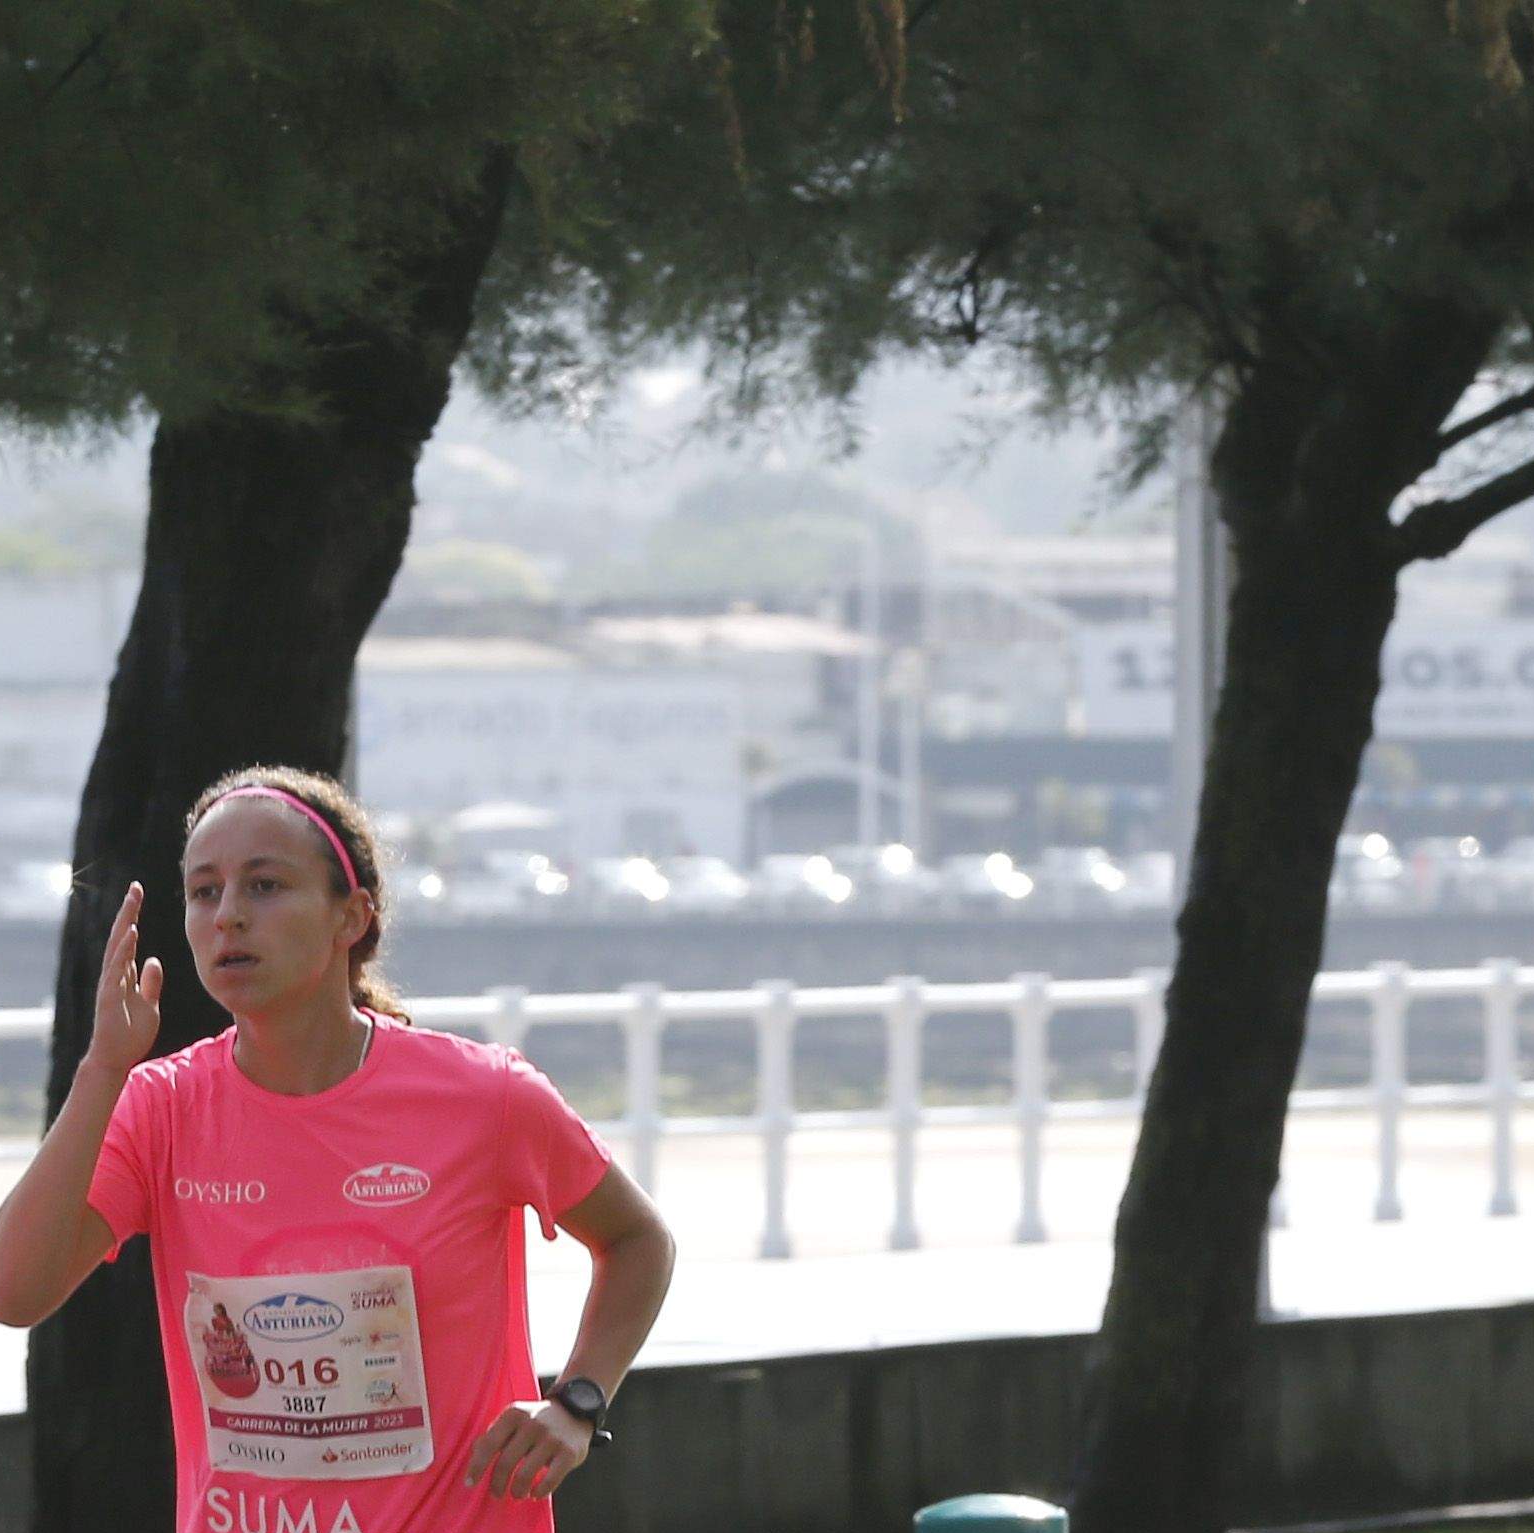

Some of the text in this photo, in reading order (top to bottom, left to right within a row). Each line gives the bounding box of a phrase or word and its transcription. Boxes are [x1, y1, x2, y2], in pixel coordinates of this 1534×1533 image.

[175, 1178, 266, 1204] OYSHO
[351, 1180, 423, 1198] ASTURIANA
[351, 1297, 397, 1310] SUMA
[252, 1312, 335, 1329] ASTURIANA
[264, 1357, 339, 1386] 016
[282, 1396, 326, 1413] 3887
[226, 1413, 404, 1434] CARRERA DE LA MUJER 2023
[228, 1440, 285, 1464] OYSHO
[340, 1443, 413, 1462] Santander
